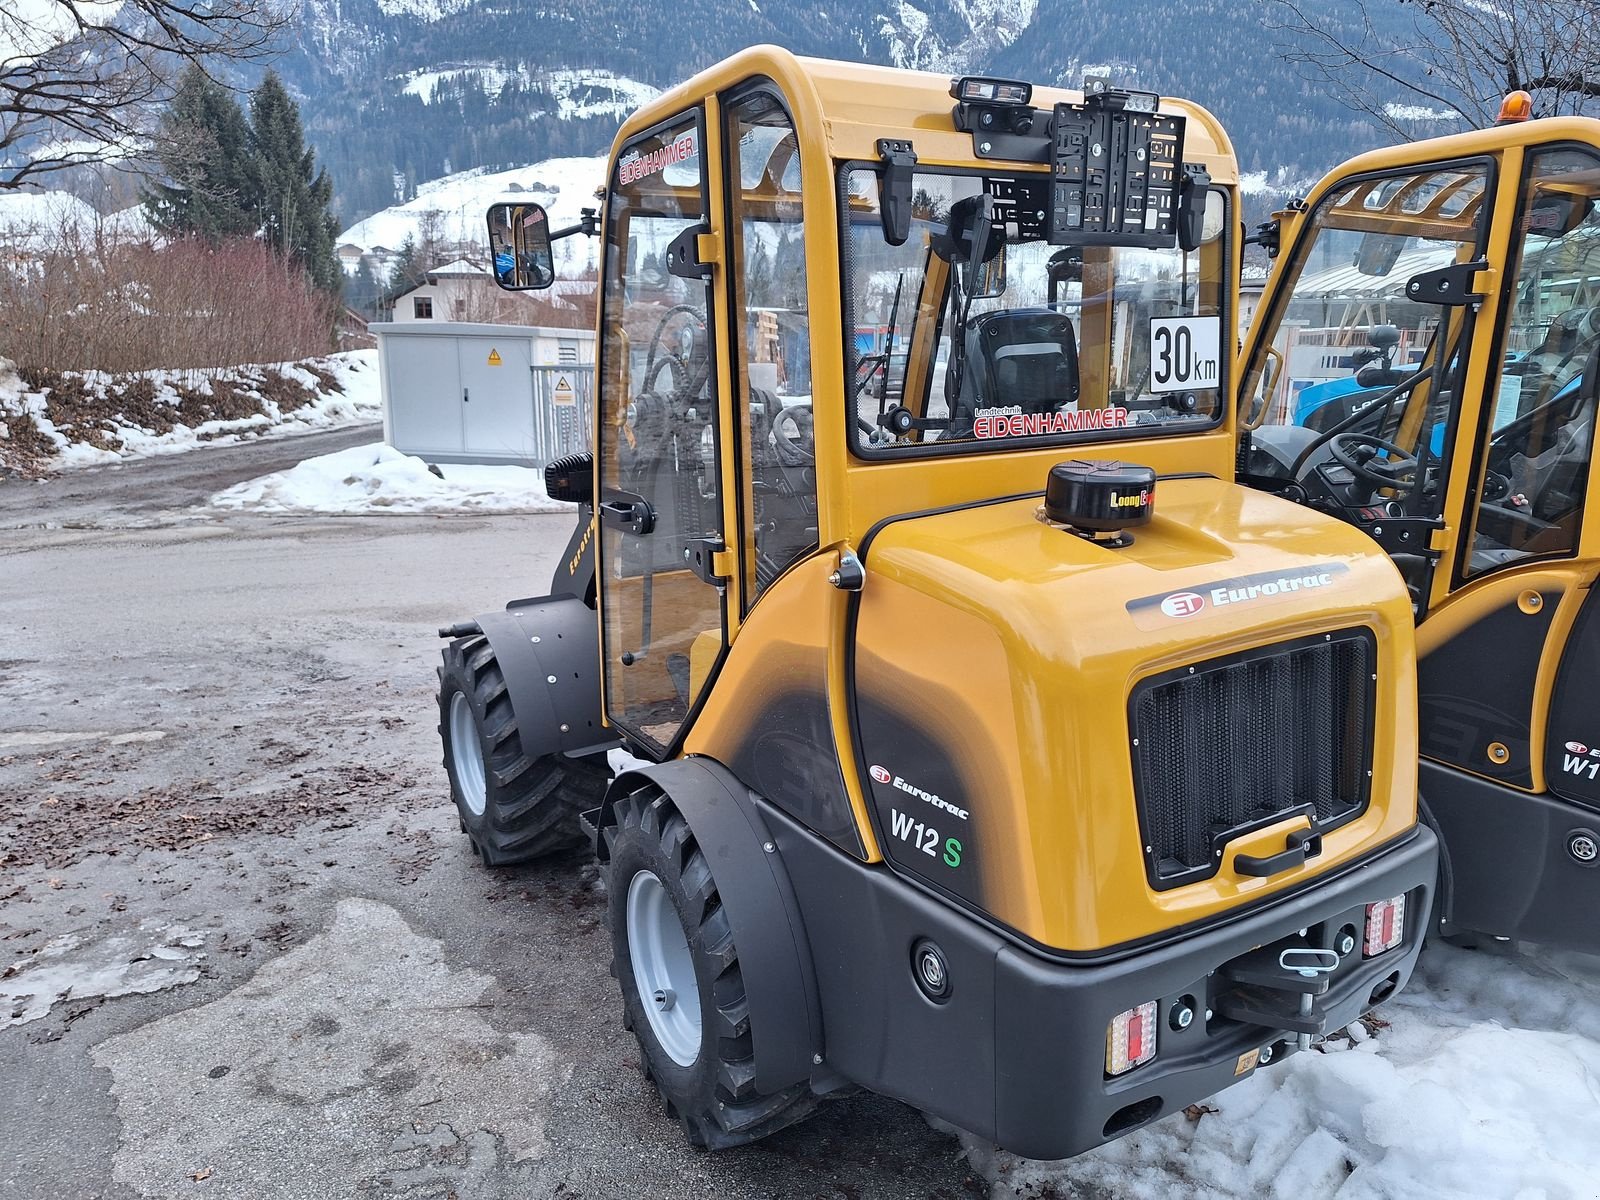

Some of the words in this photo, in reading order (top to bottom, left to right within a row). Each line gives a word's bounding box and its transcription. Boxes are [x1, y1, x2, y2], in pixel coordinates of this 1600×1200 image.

[619, 136, 694, 185] EIDENHAMMER
[1154, 325, 1191, 384] 30
[1194, 351, 1216, 380] km
[974, 407, 1128, 438] EIDENHAMMER
[975, 405, 1022, 417] Landtechnik
[1210, 573, 1332, 607] Eurotrac
[892, 776, 969, 820] Eurotrac
[891, 808, 939, 857] W12
[943, 837, 962, 868] S
